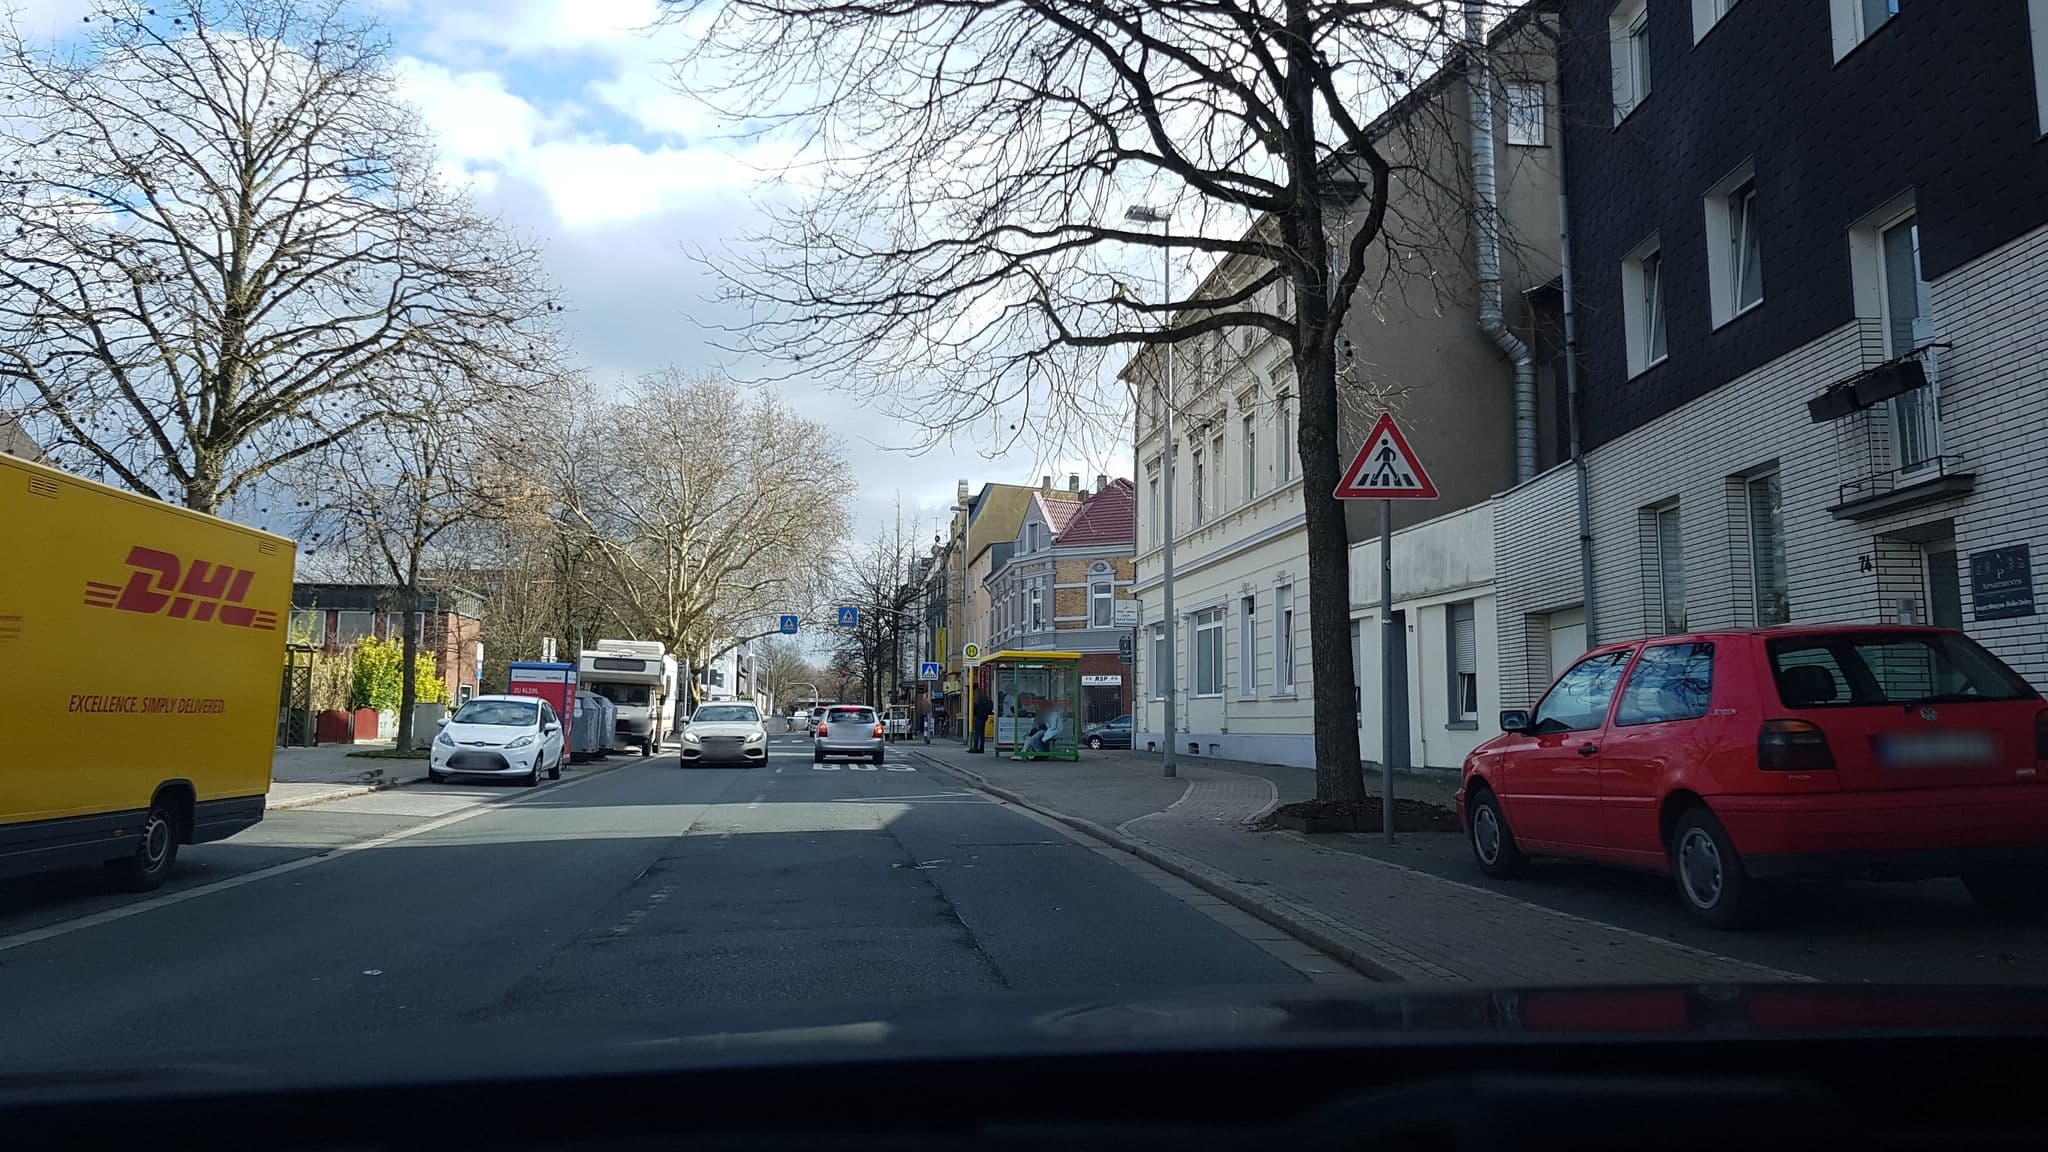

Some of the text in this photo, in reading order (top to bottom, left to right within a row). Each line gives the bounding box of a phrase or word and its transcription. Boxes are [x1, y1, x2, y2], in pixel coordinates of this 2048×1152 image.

[115, 545, 258, 627] DHL
[141, 697, 177, 714] SIMPLY
[813, 763, 917, 771] BUS
